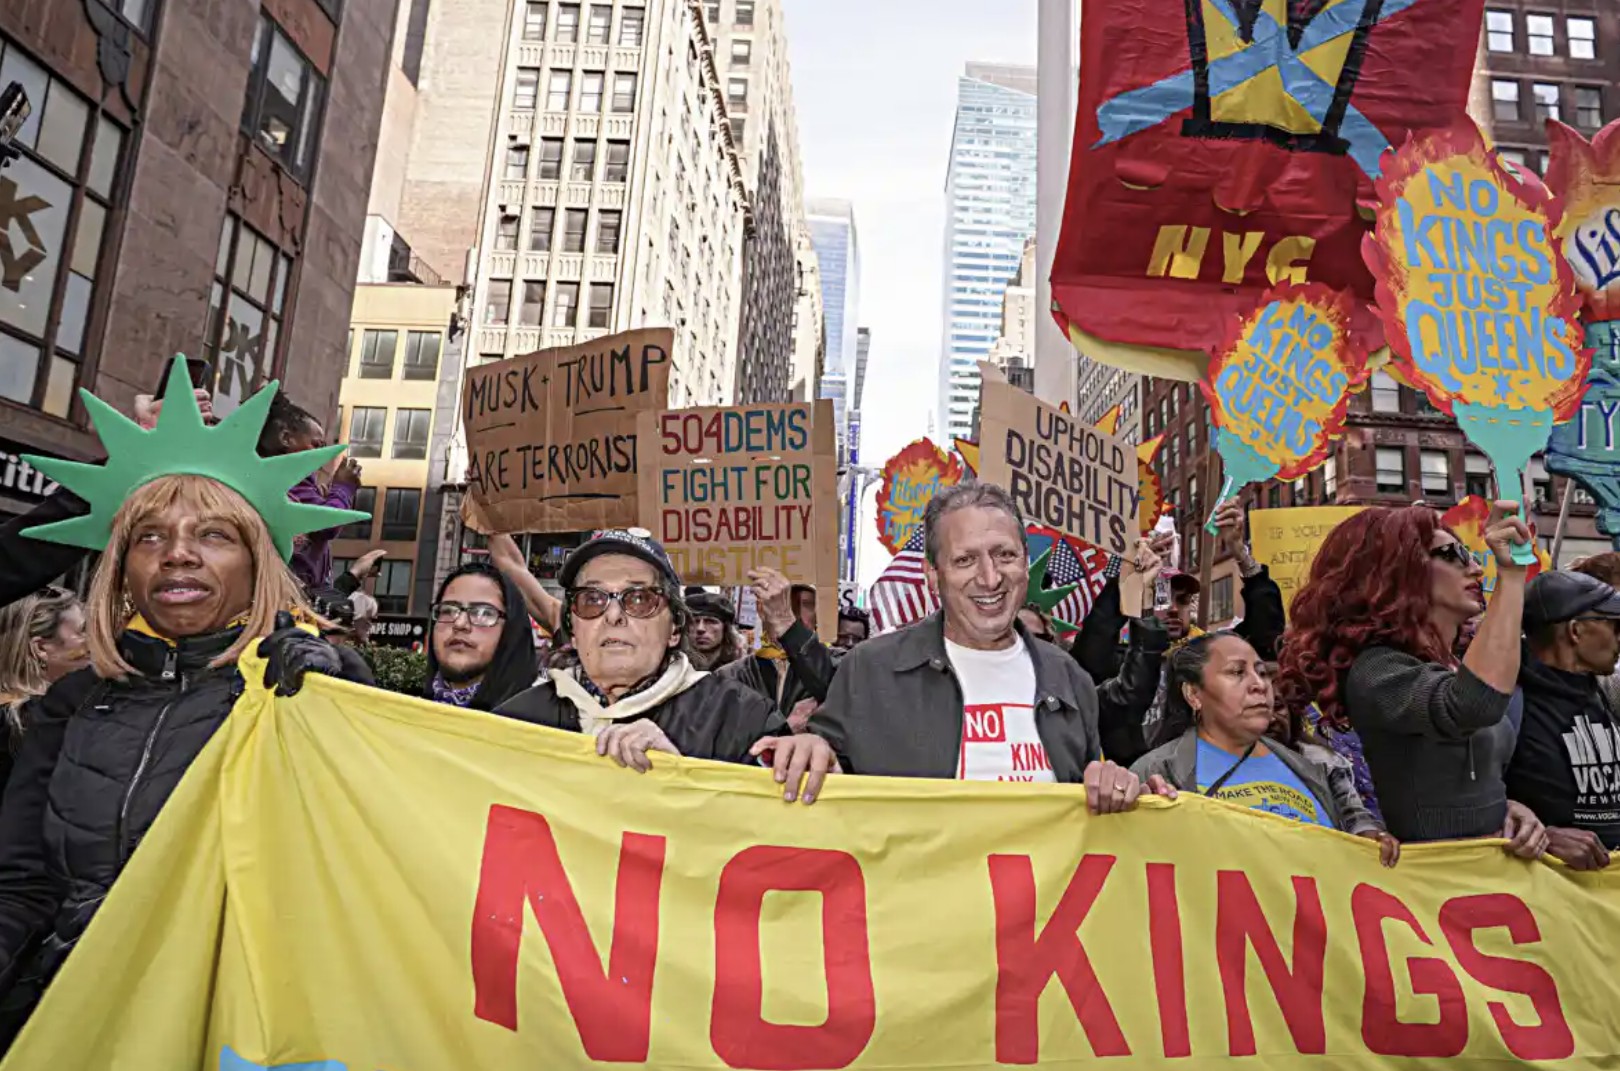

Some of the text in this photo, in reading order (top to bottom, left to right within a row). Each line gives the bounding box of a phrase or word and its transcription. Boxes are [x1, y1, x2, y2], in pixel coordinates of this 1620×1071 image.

[1426, 168, 1498, 217] NO
[1395, 196, 1550, 285] KINGS
[1427, 273, 1533, 312] JUST
[1246, 301, 1349, 405] KINGS
[1288, 304, 1333, 349] NO
[1405, 299, 1576, 391] QUEENS
[469, 365, 539, 419] MUSK
[558, 345, 667, 407] TRUMP
[1215, 364, 1321, 456] QUEENS
[1244, 353, 1313, 407] JUST
[469, 435, 637, 495] ARE TERRORIST
[1037, 406, 1124, 474] UPHOLD
[663, 464, 811, 503] FIGHT FOR
[1006, 428, 1140, 520] DISABILITY
[662, 505, 812, 543] DISABILITY
[1011, 469, 1126, 553] RIGHTS
[388, 623, 412, 636] SHOP
[965, 710, 1000, 739] NO
[1213, 787, 1253, 801] MAKE
[1253, 784, 1278, 795] THE
[471, 803, 1576, 1070] NO KINGS
